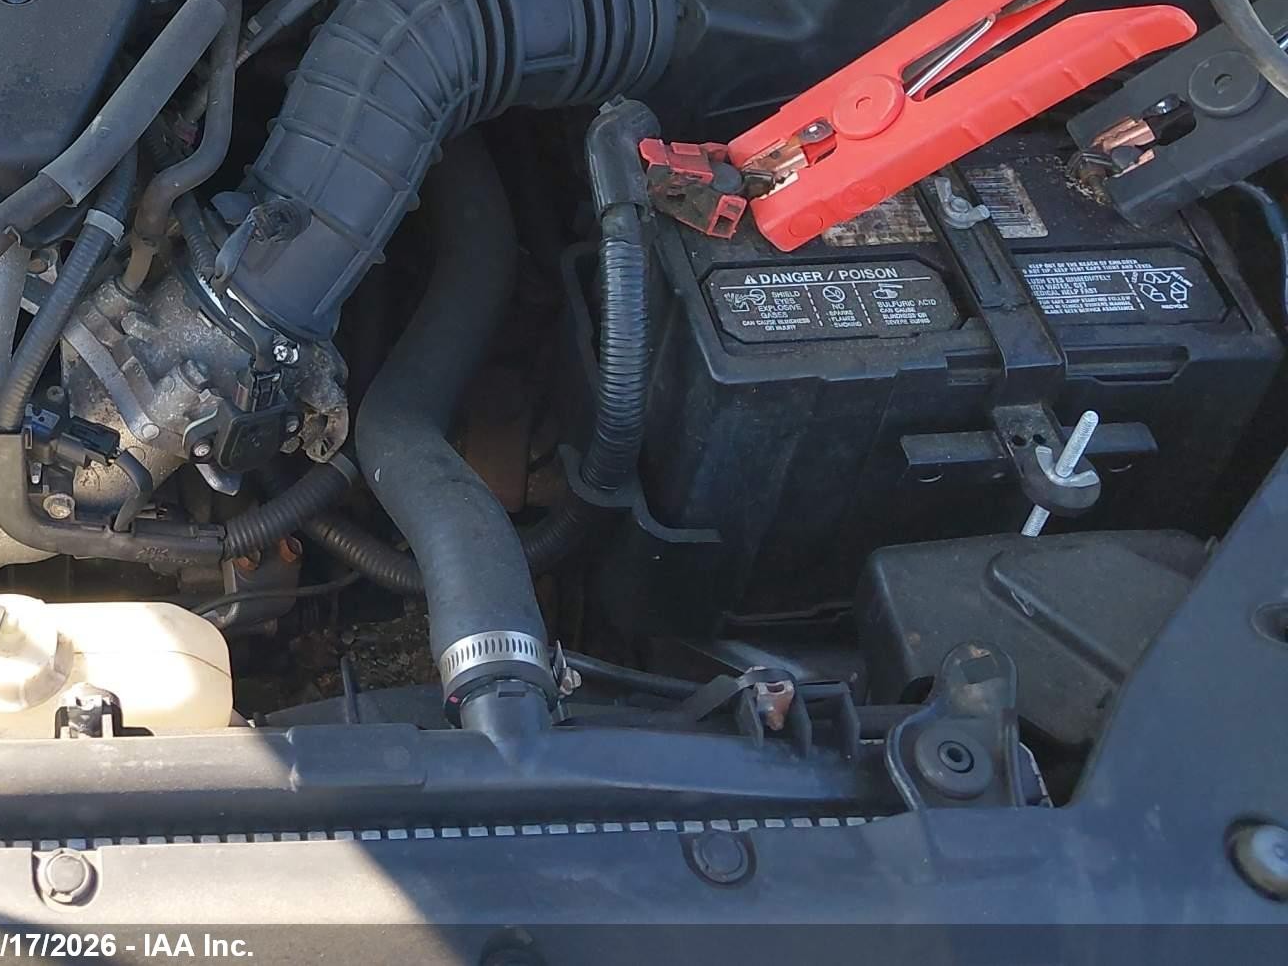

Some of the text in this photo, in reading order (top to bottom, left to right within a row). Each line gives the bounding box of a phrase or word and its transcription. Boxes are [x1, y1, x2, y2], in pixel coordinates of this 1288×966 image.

[758, 271, 823, 284] DANGER
[838, 267, 898, 280] POISON
[1065, 274, 1111, 283] IMMEDIATELY
[771, 290, 801, 298] SHIELD
[757, 303, 803, 312] EXPLOSIVE
[876, 298, 937, 308] SULFURIC ACID
[760, 311, 789, 319] GASES
